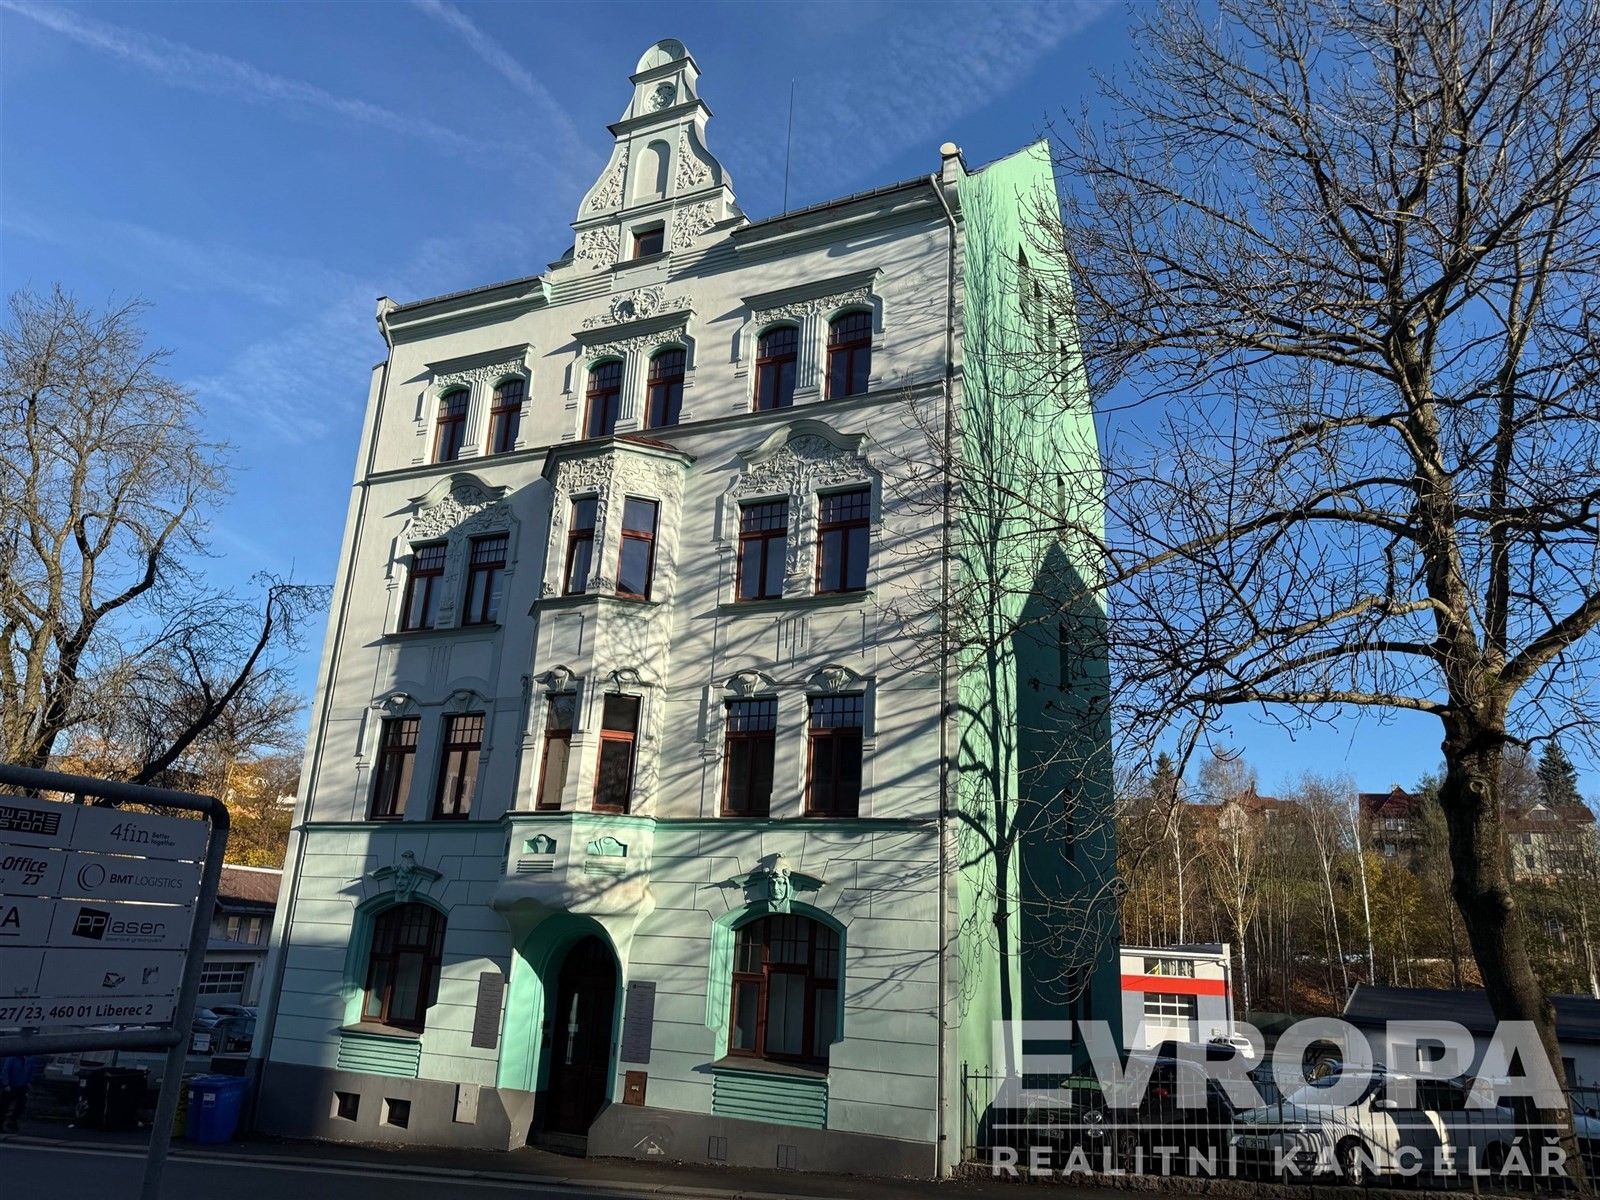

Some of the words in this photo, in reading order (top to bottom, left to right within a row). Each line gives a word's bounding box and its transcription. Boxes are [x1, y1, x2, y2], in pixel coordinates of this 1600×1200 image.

[110, 822, 150, 844] 4fin
[109, 873, 134, 885] BMT
[134, 875, 183, 889] LOGISTICS
[49, 1005, 74, 1018] 460
[77, 1004, 92, 1017] 01
[96, 1004, 143, 1016] Liberec
[145, 1004, 153, 1016] 2
